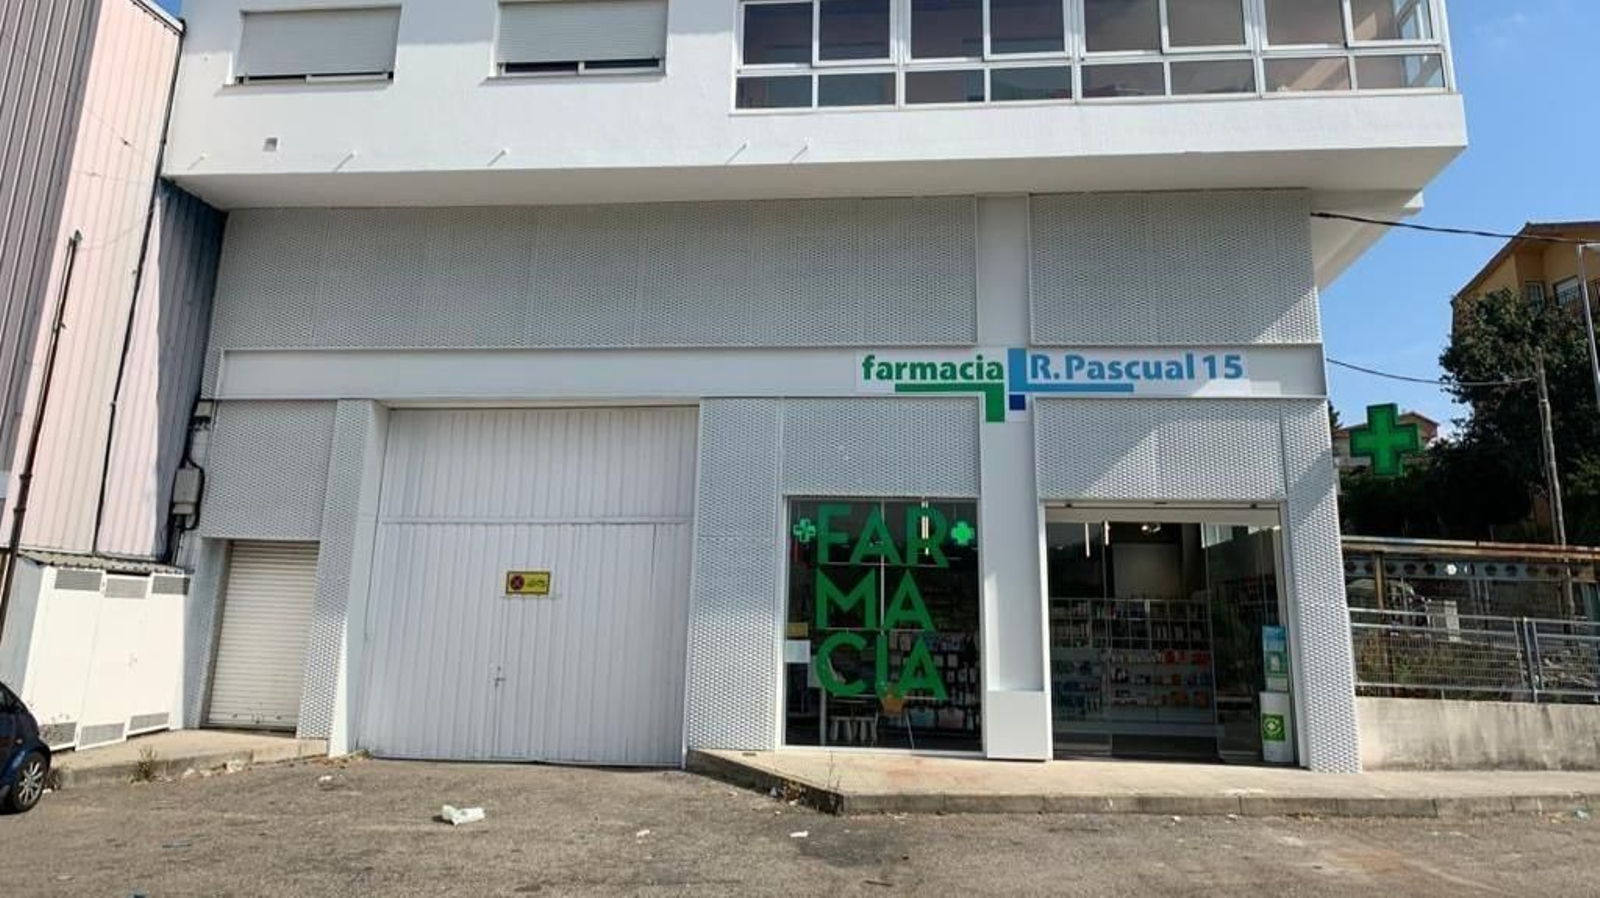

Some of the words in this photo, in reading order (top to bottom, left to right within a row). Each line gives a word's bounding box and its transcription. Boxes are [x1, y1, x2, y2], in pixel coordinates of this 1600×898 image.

[861, 353, 1004, 381] farmacia
[1202, 354, 1243, 379] 15
[817, 503, 949, 567] FAR
[815, 567, 937, 632] MA
[815, 631, 949, 701] CIA
